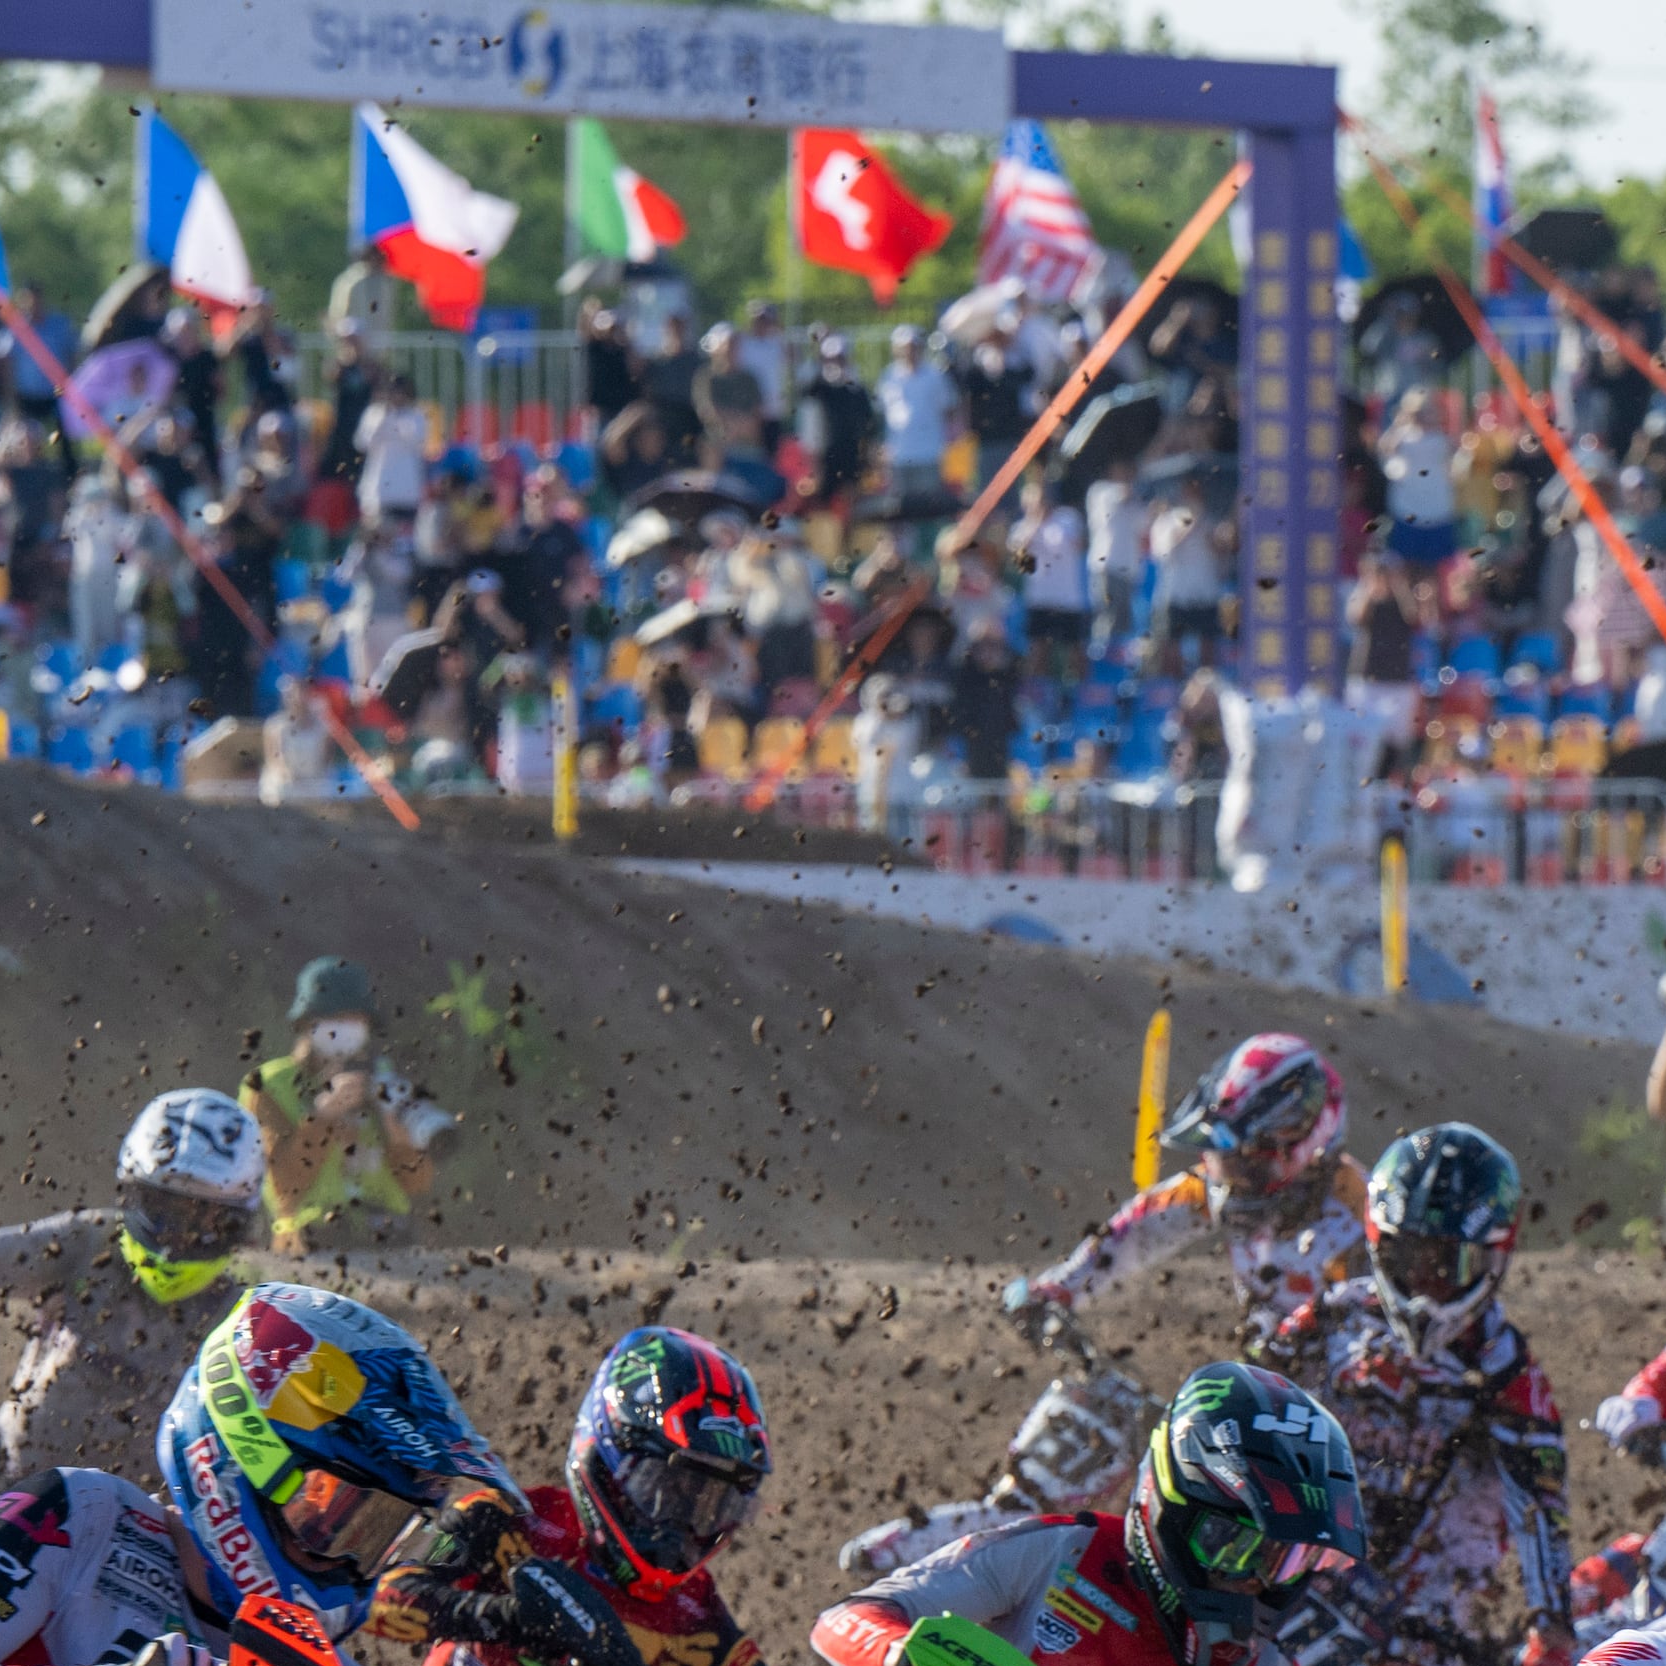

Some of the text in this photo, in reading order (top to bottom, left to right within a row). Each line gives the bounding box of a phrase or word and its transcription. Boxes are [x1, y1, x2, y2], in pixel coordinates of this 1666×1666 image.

[310, 7, 498, 80] SHRCB
[373, 1407, 440, 1458] AIROH
[185, 1433, 241, 1527] Red
[1035, 1614, 1077, 1646] MOTO
